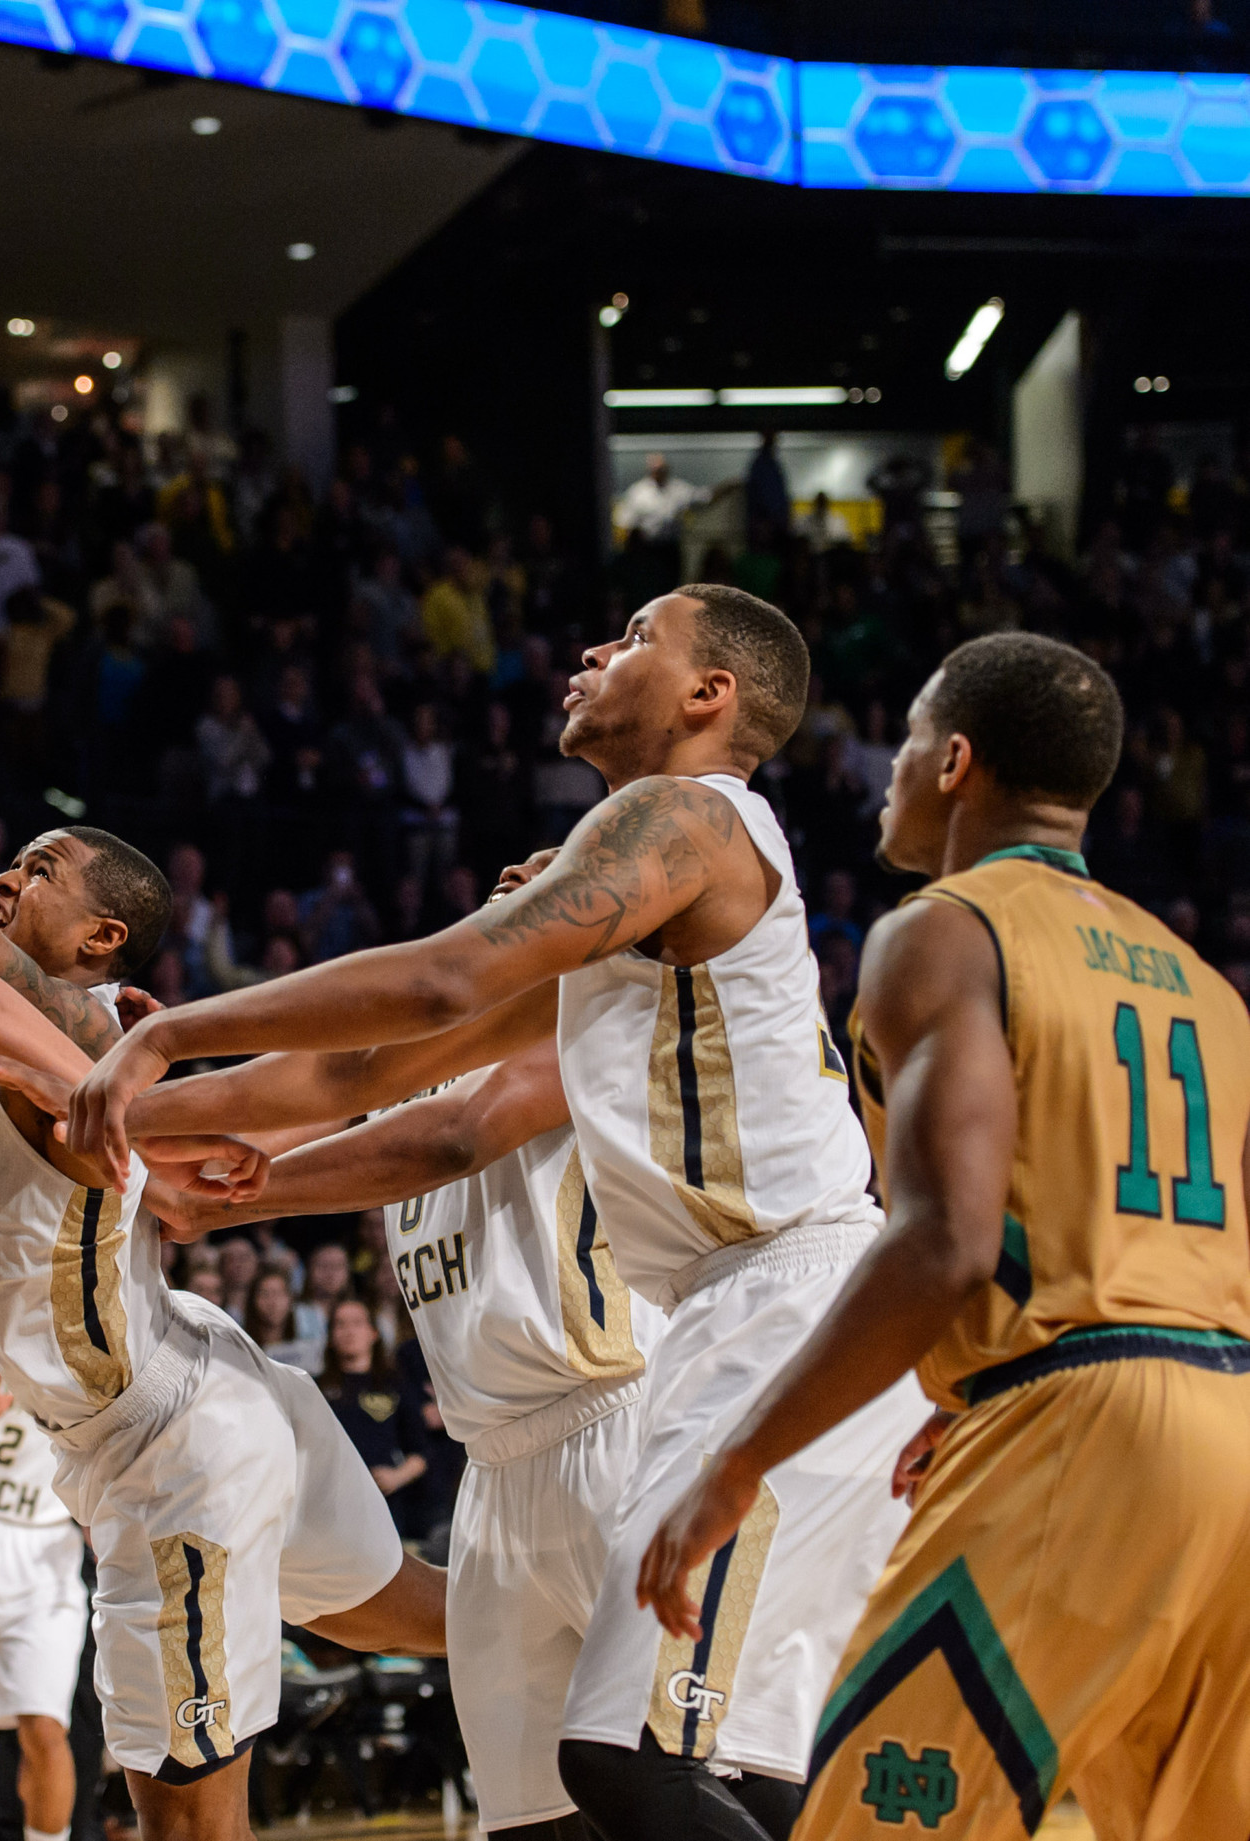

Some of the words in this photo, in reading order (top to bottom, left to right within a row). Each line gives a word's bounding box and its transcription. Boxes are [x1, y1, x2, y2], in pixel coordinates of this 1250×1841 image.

[1112, 1000, 1226, 1231] 11
[175, 1694, 227, 1730] GT
[667, 1669, 727, 1722] GT
